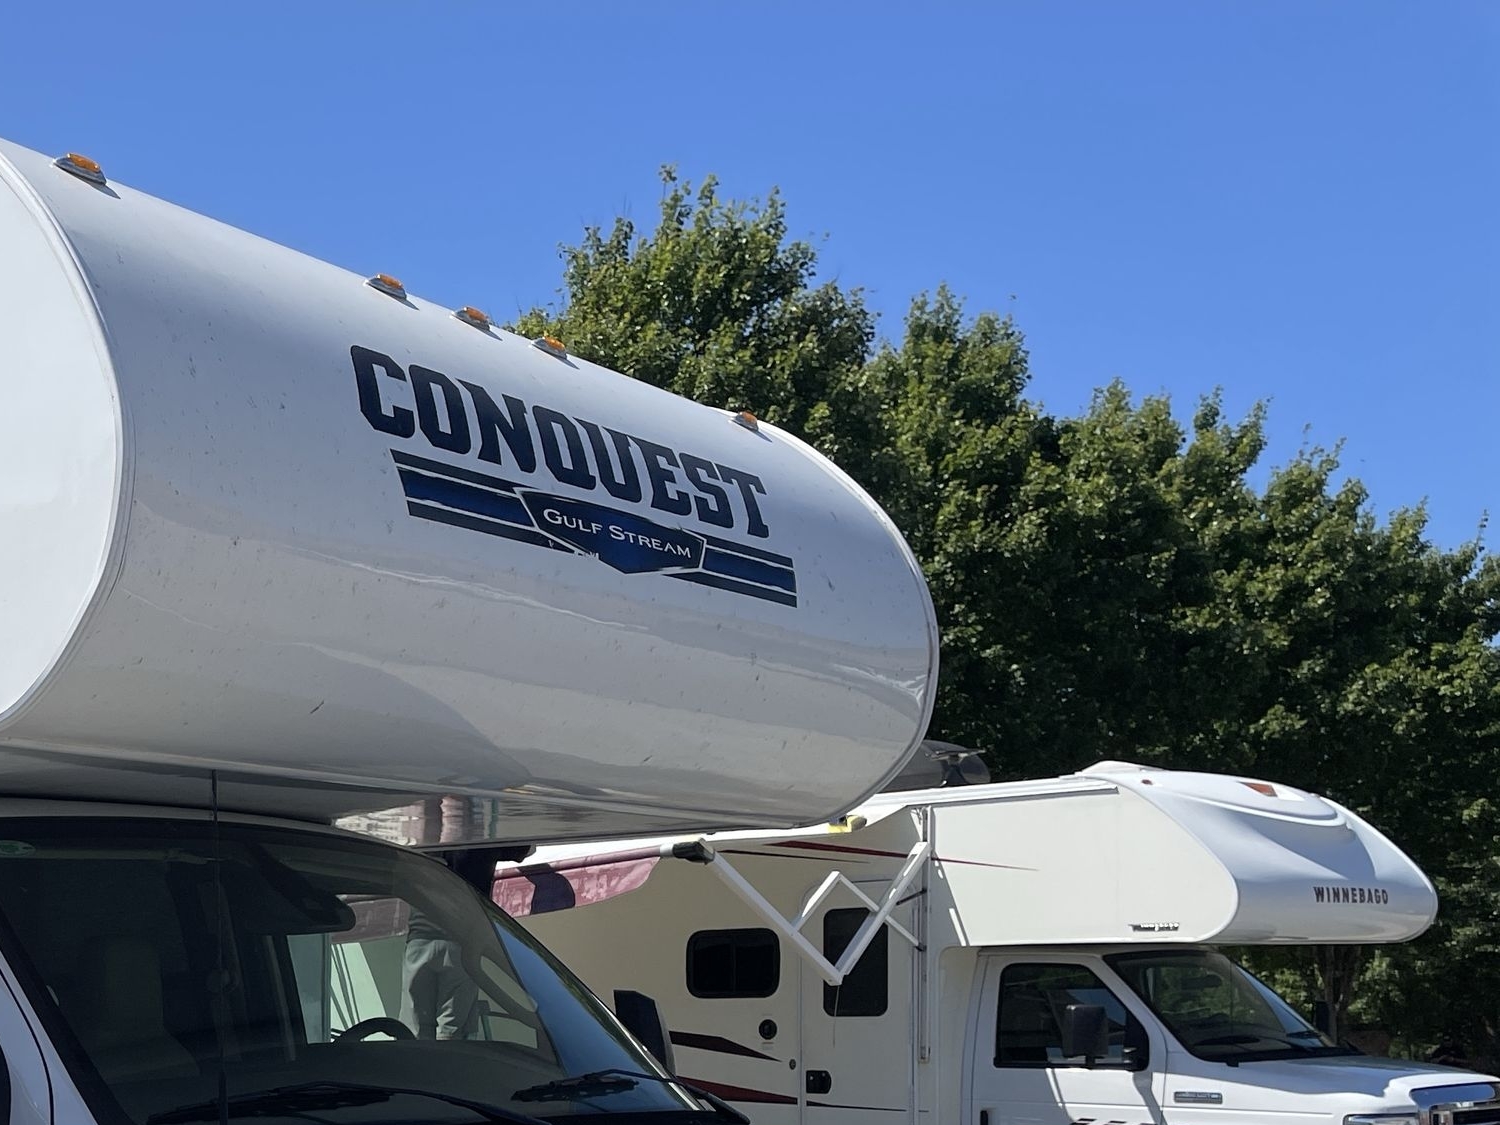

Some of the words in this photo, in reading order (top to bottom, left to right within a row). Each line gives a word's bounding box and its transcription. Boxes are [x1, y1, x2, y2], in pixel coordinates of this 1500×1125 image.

[350, 345, 769, 538] CONQUEST
[543, 509, 602, 534] GULF
[608, 525, 692, 558] STREAM
[1313, 886, 1389, 904] WINNEBAGO
